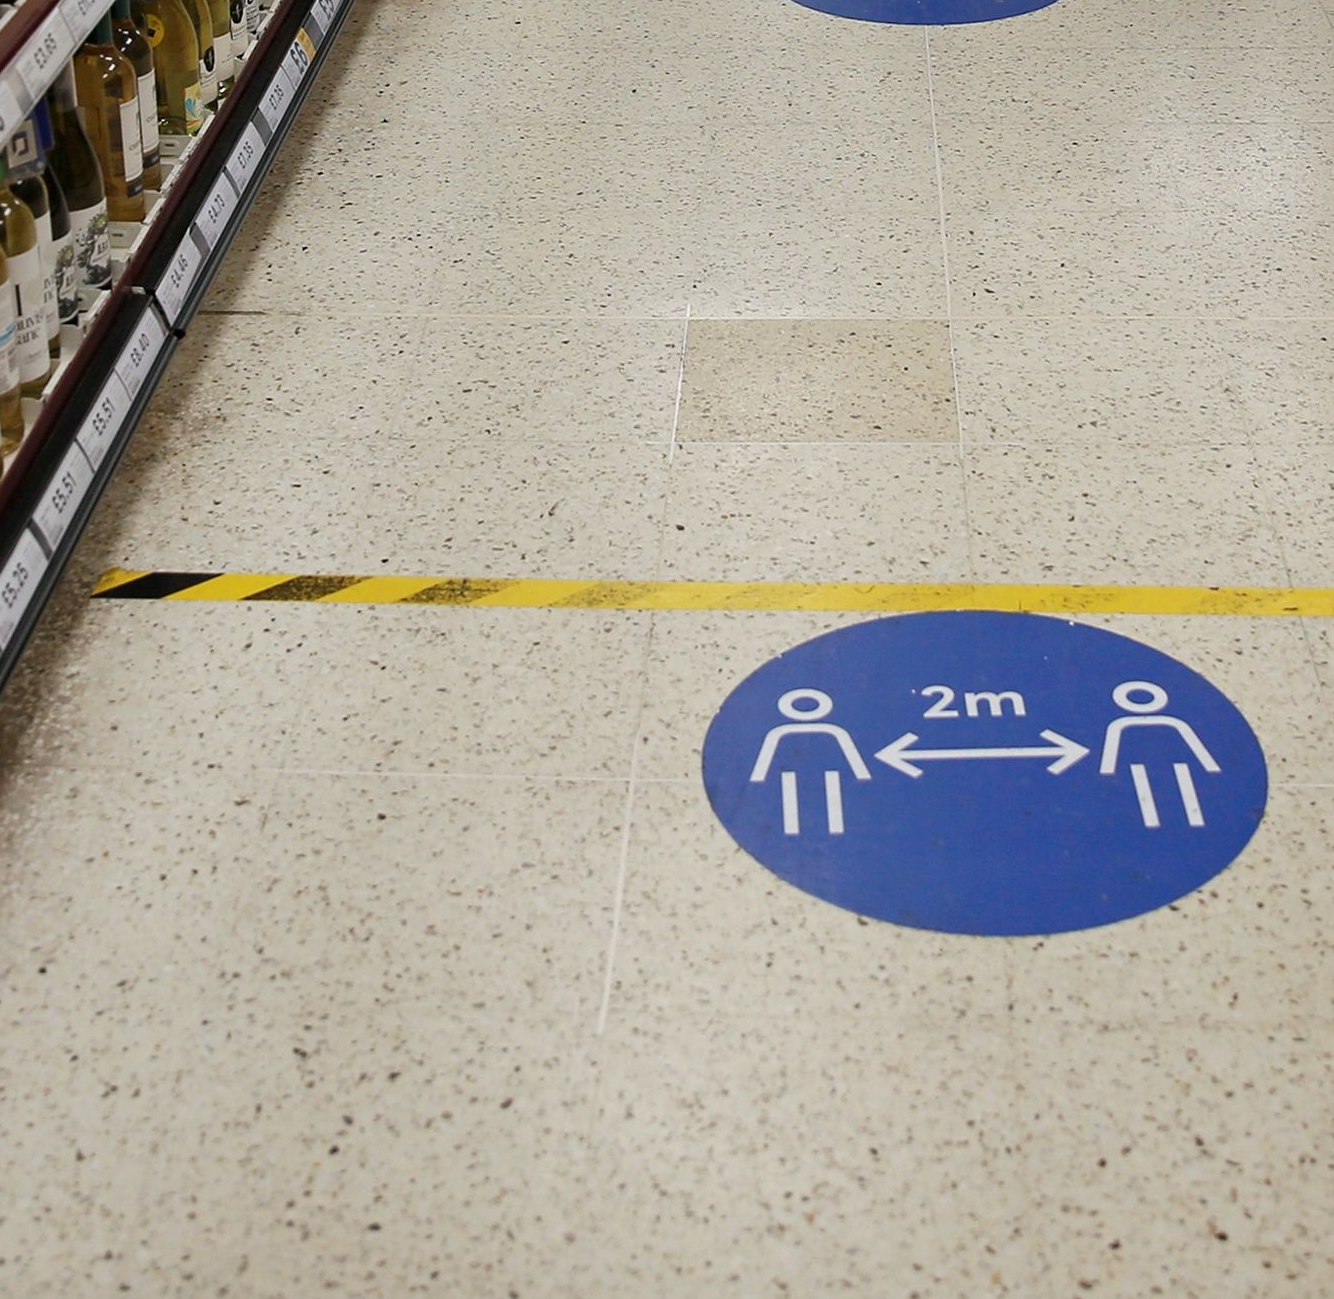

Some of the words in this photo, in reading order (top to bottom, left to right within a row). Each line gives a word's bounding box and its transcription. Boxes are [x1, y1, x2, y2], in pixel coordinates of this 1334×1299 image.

[289, 40, 309, 74] £6
[171, 253, 190, 288] £4.46
[91, 397, 116, 437] £5.51
[51, 471, 78, 515] £5.51
[3, 563, 29, 610] £5.25
[921, 683, 1029, 722] 2m
